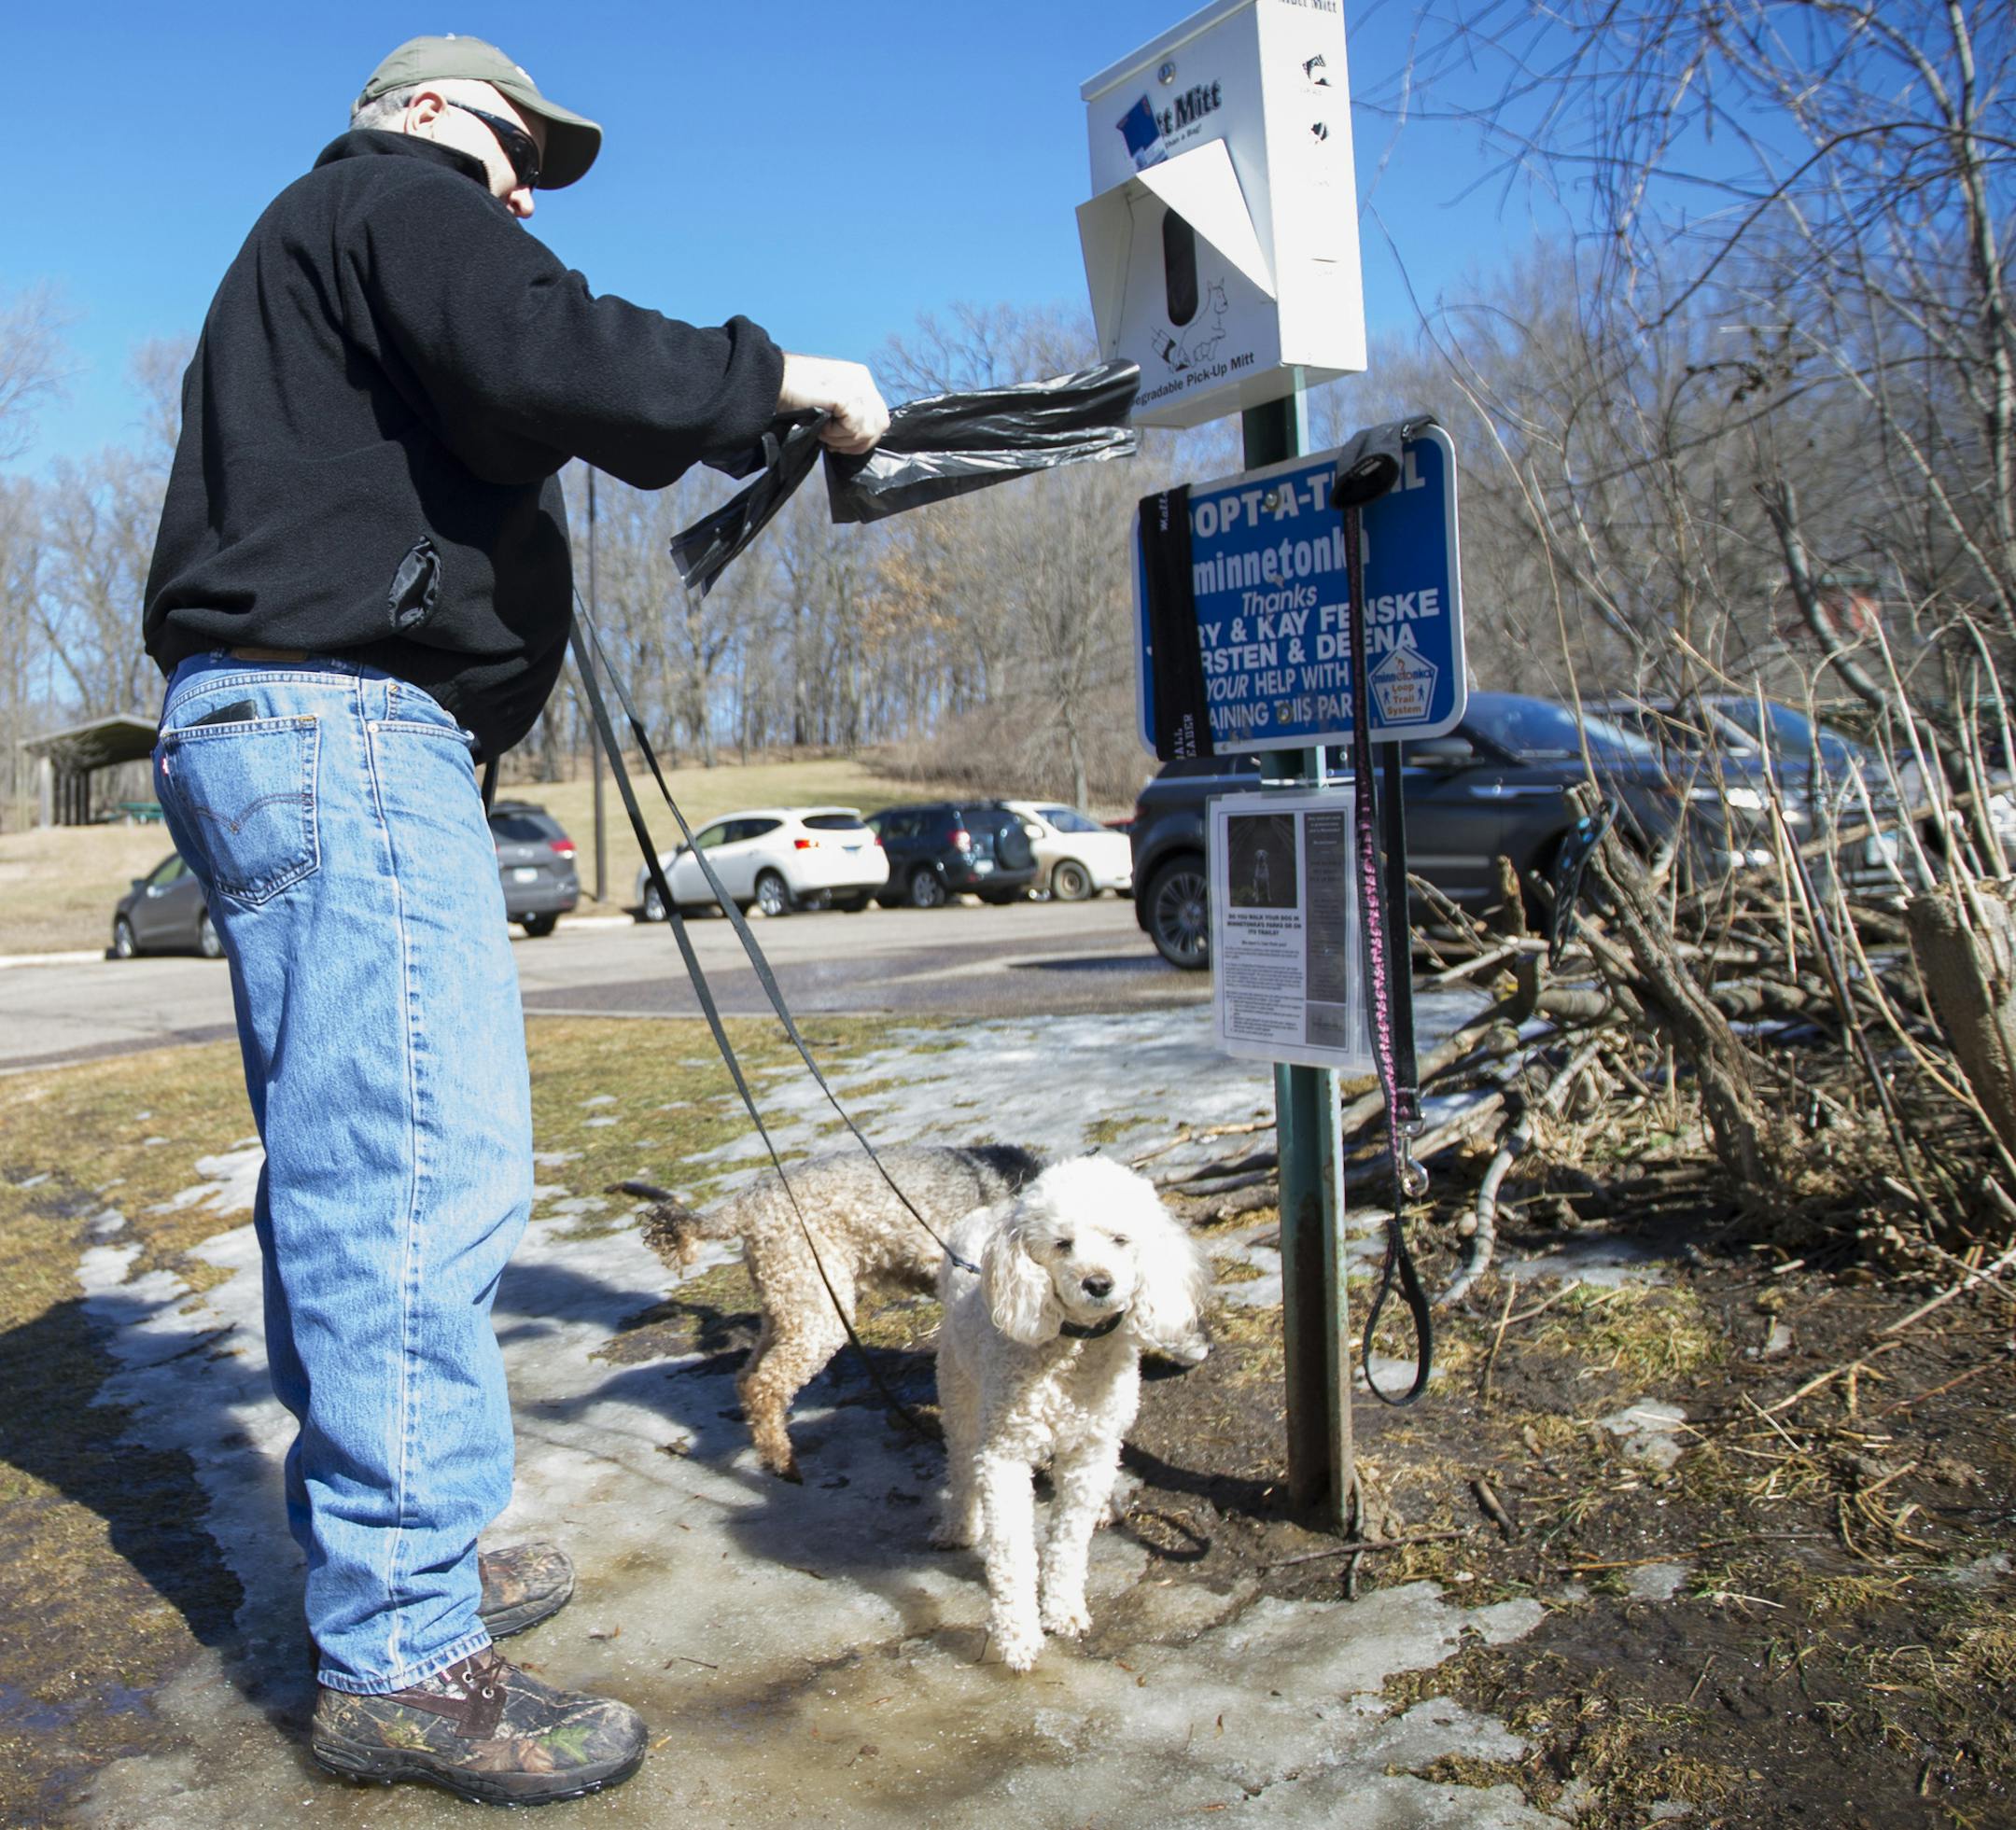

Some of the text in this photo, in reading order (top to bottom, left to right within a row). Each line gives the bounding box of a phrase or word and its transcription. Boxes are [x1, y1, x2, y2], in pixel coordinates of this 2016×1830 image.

[1174, 78, 1222, 132] Mitt
[1135, 352, 1254, 407] egradable Pick-Up Mitt
[1230, 617, 1248, 643] &
[1257, 608, 1309, 641] KAY
[1320, 588, 1440, 632] FENSKE
[1241, 583, 1318, 618] Thanks
[1200, 641, 1278, 675] RSTEN
[1288, 637, 1307, 664] &
[1206, 661, 1350, 702] YOUR HELP WITH
[1393, 693, 1415, 704] Trail
[1387, 705, 1422, 717] System
